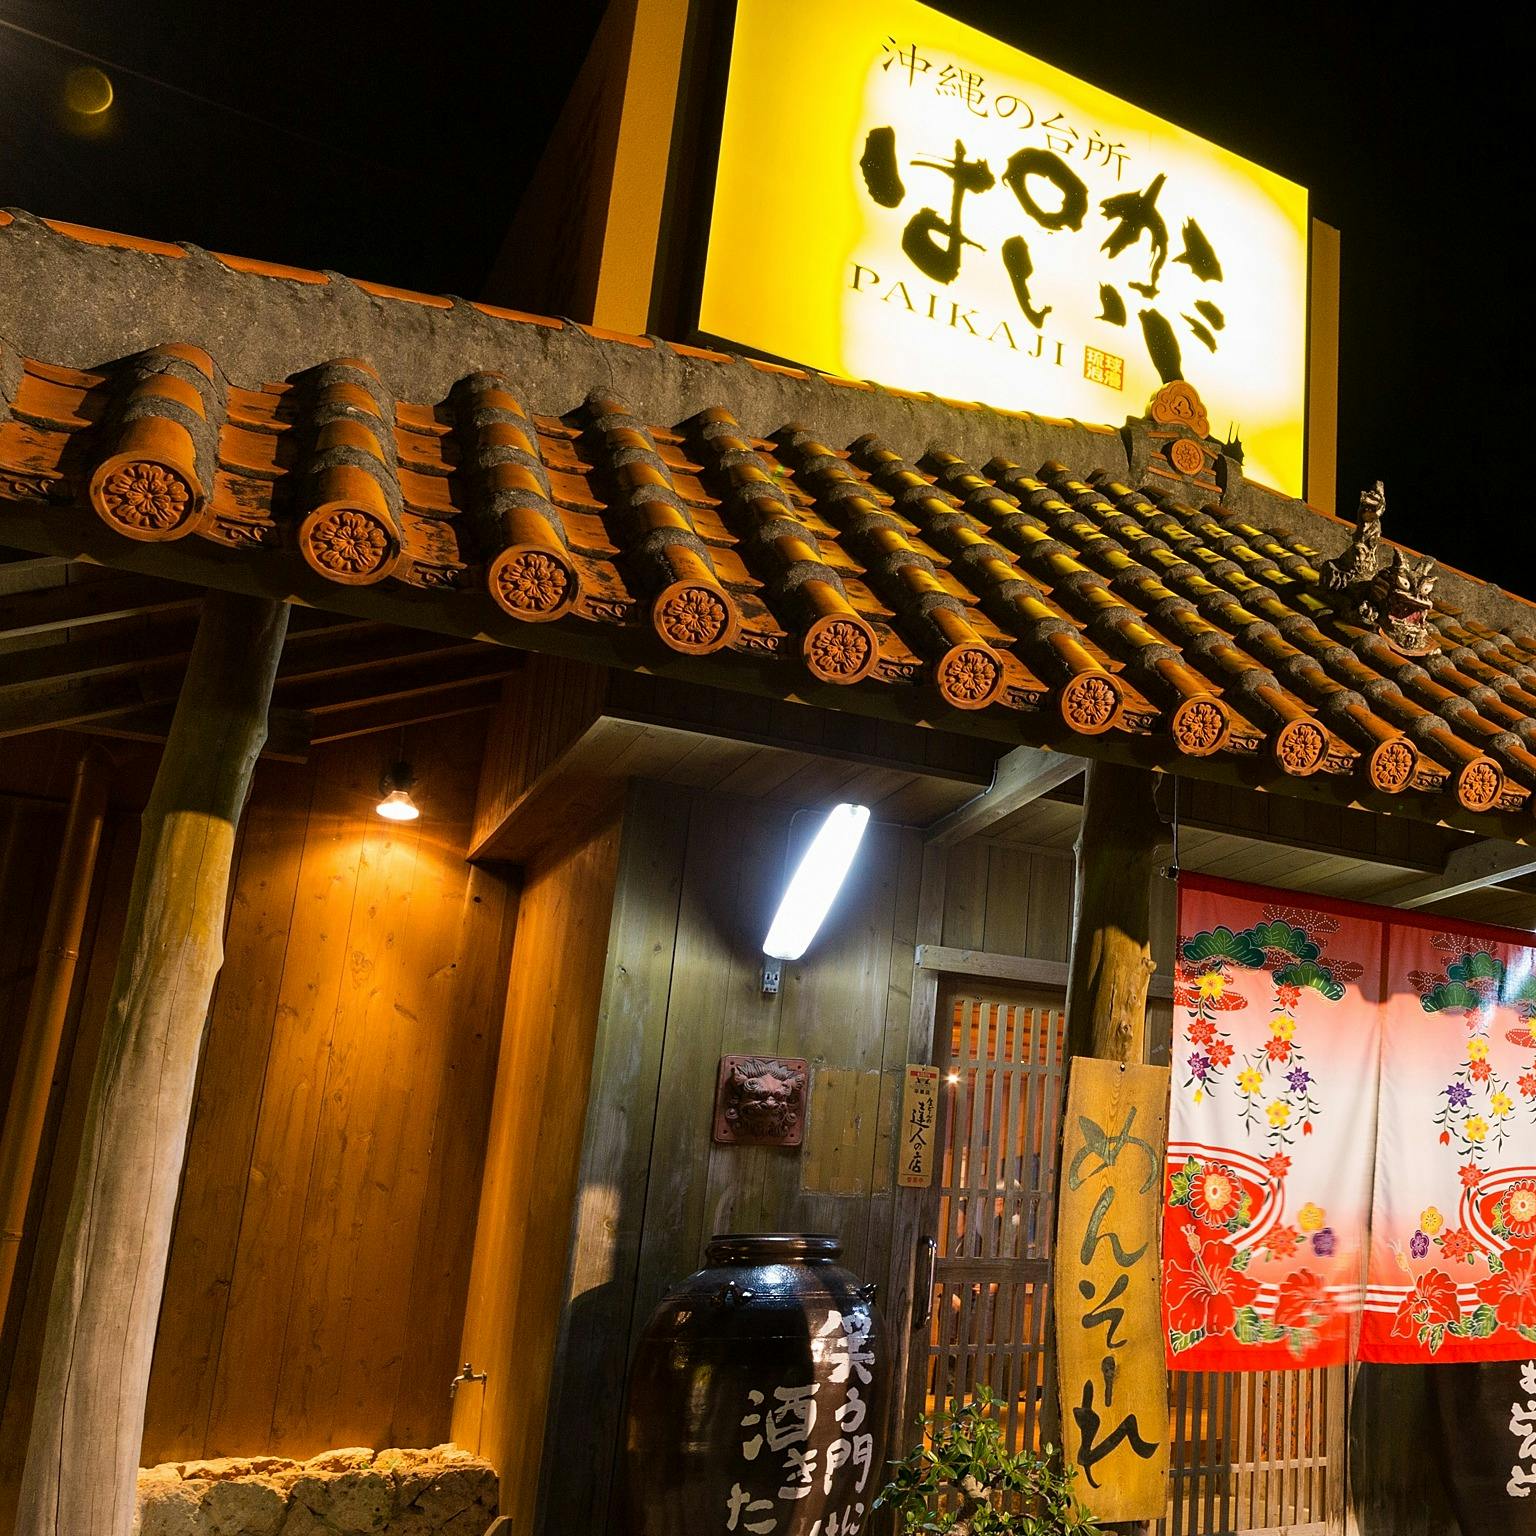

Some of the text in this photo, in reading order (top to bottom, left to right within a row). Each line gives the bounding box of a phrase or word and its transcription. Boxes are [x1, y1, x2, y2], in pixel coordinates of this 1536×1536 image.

[880, 35, 1132, 182] 沖縄の台所
[848, 262, 1067, 368] PAIKAJI
[1069, 1106, 1160, 1489] めんそーれ
